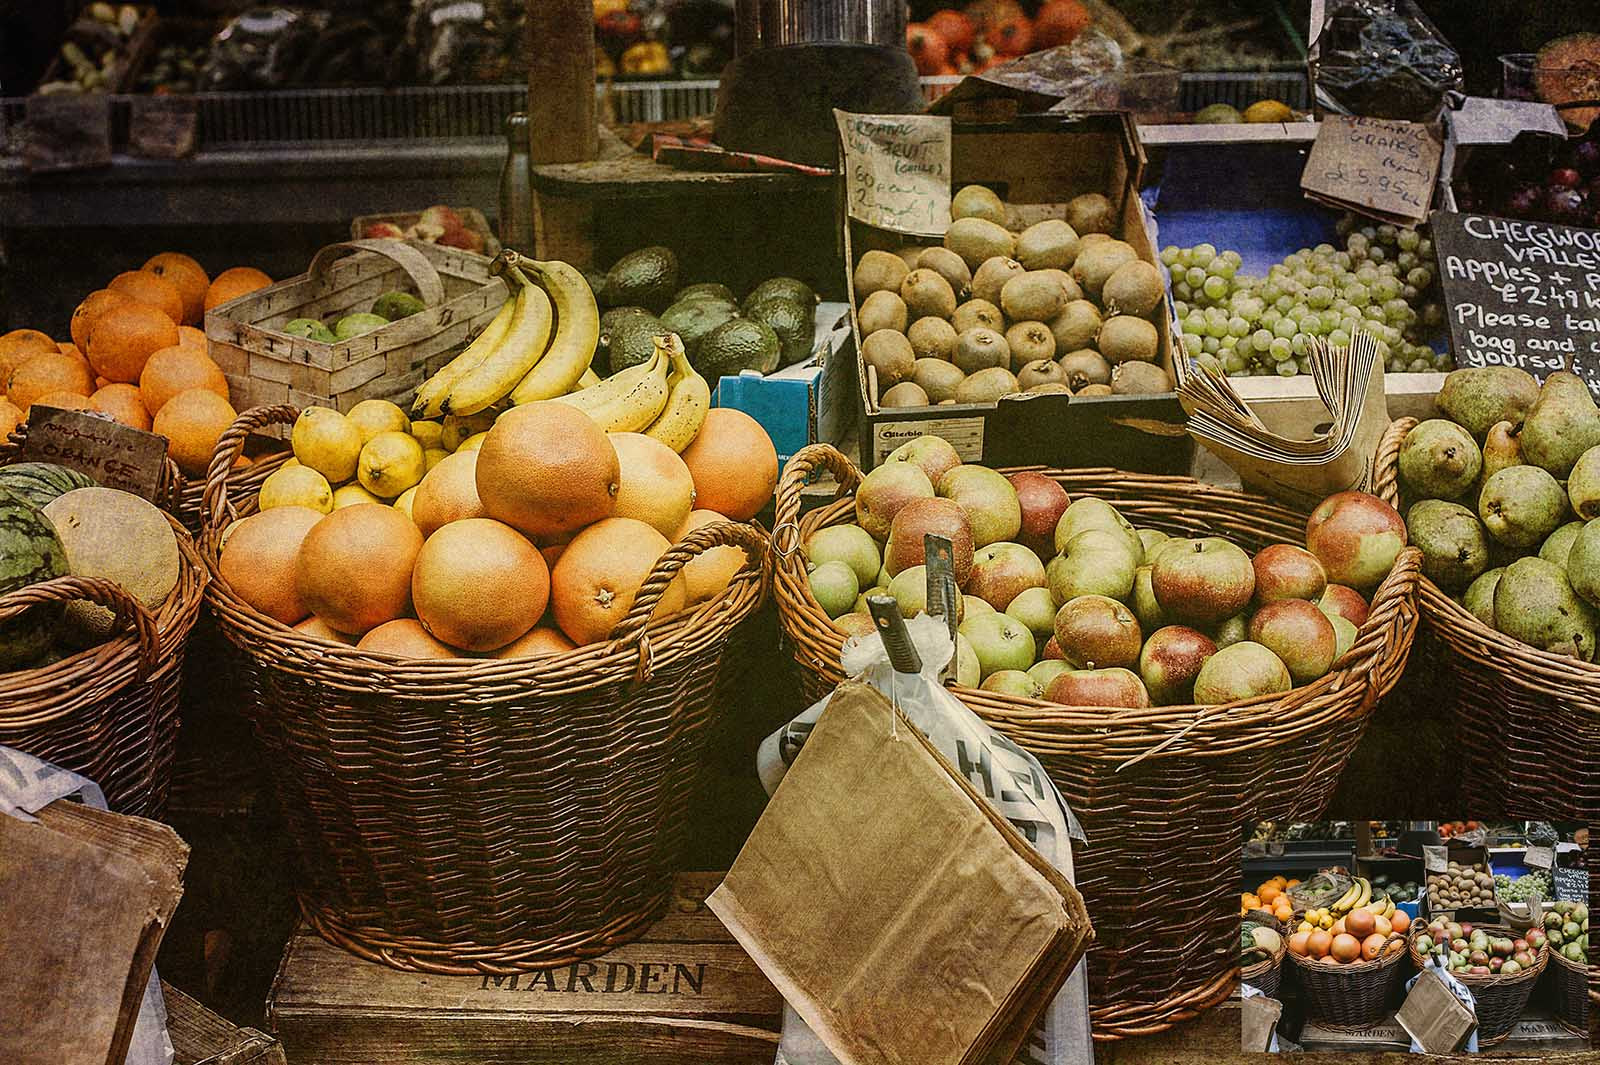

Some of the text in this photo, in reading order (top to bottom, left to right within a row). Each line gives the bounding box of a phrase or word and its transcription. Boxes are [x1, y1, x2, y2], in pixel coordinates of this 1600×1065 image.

[1446, 255, 1542, 284] Apples
[1504, 243, 1600, 270] VALLE
[1454, 303, 1551, 328] Please
[1468, 330, 1516, 354] bag
[1526, 337, 1576, 353] and
